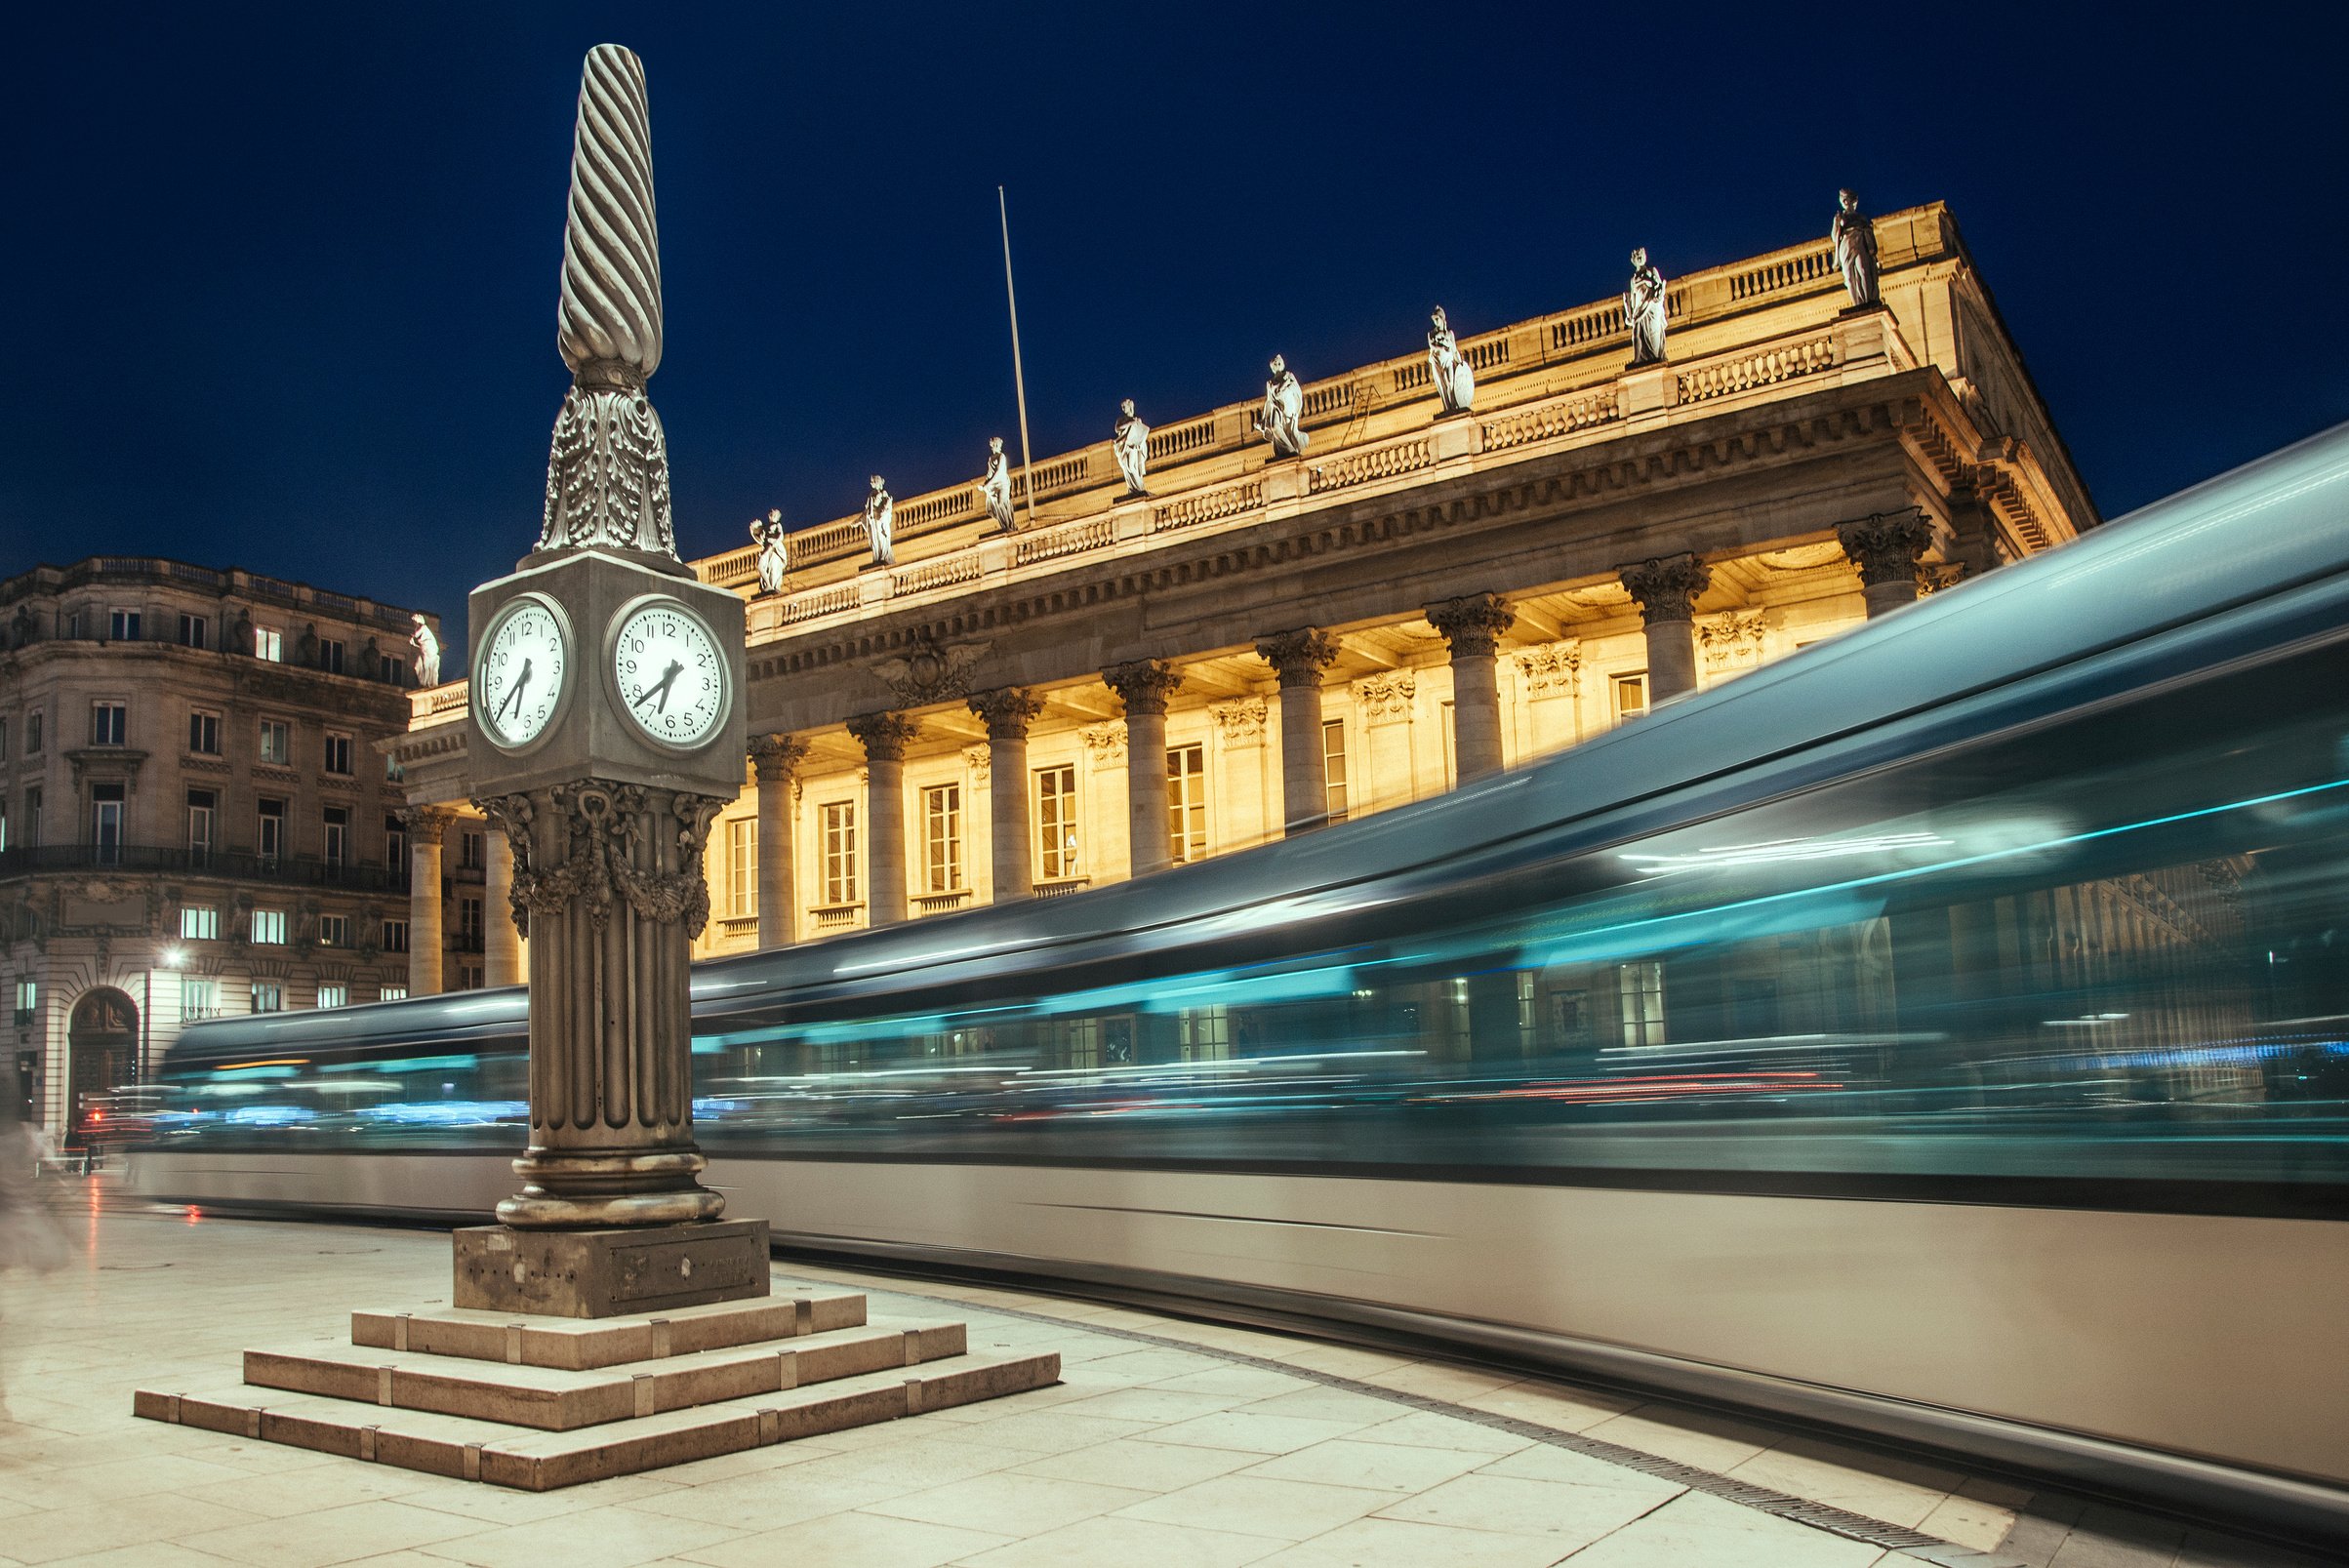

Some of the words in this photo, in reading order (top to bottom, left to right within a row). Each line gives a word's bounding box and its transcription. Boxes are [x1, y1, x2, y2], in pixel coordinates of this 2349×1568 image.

[522, 622, 533, 636] 12
[647, 623, 654, 638] 11
[663, 622, 676, 638] 12
[509, 631, 515, 646] 11
[548, 637, 557, 652] 2
[631, 638, 645, 653] 10
[498, 653, 508, 667] 10
[626, 660, 637, 673] 9
[697, 654, 707, 667] 2
[552, 661, 561, 674] 3
[494, 676, 503, 690] 9
[702, 677, 710, 691] 3
[547, 684, 555, 698] 4
[632, 684, 643, 699] 8
[538, 704, 546, 719] 5
[646, 703, 657, 717] 7
[695, 698, 705, 711] 4
[523, 714, 532, 728] 6
[665, 714, 676, 729] 6
[683, 712, 694, 726] 5
